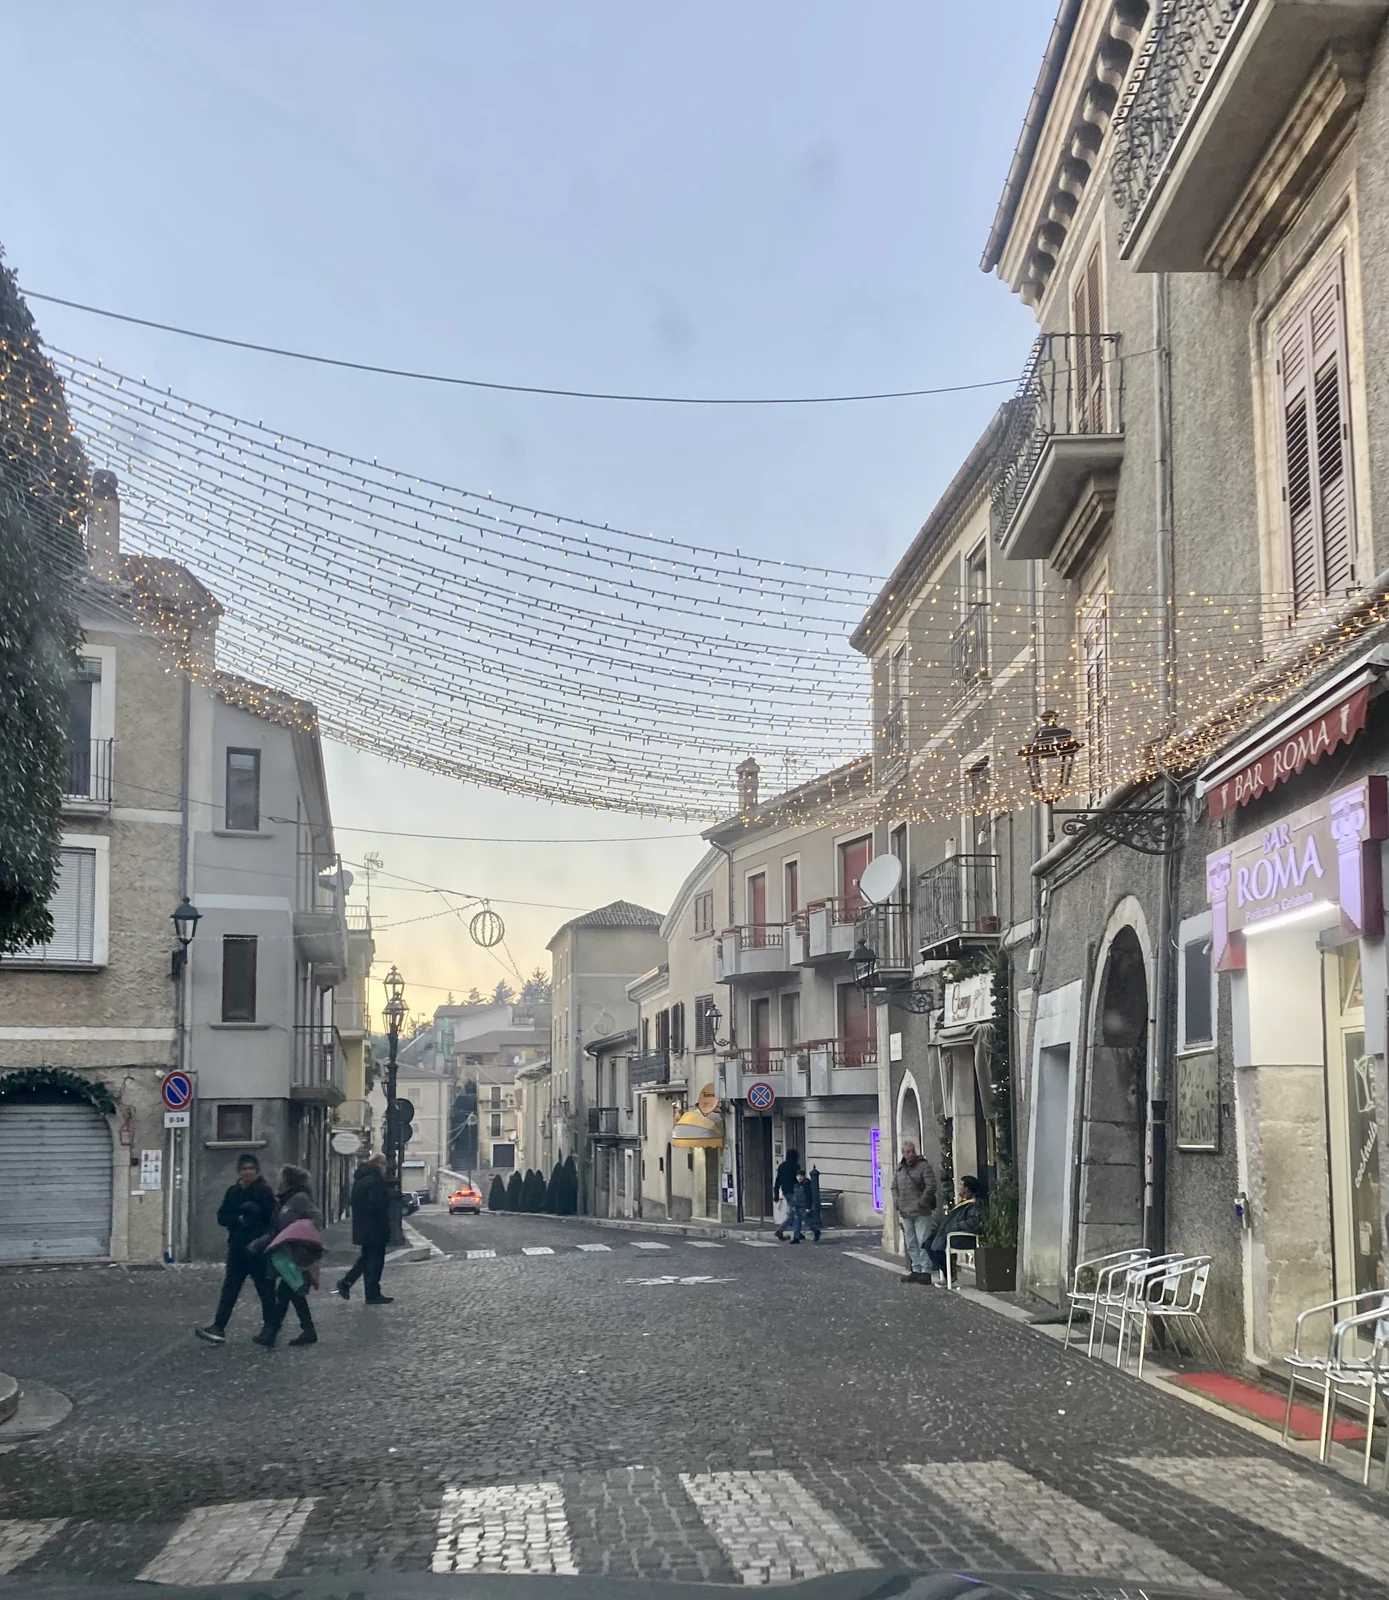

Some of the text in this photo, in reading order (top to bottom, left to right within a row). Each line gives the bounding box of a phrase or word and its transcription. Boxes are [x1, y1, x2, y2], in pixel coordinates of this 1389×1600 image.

[1235, 720, 1330, 801] BAR ROMA
[1237, 835, 1325, 909] ROMA
[1262, 823, 1292, 855] BAR
